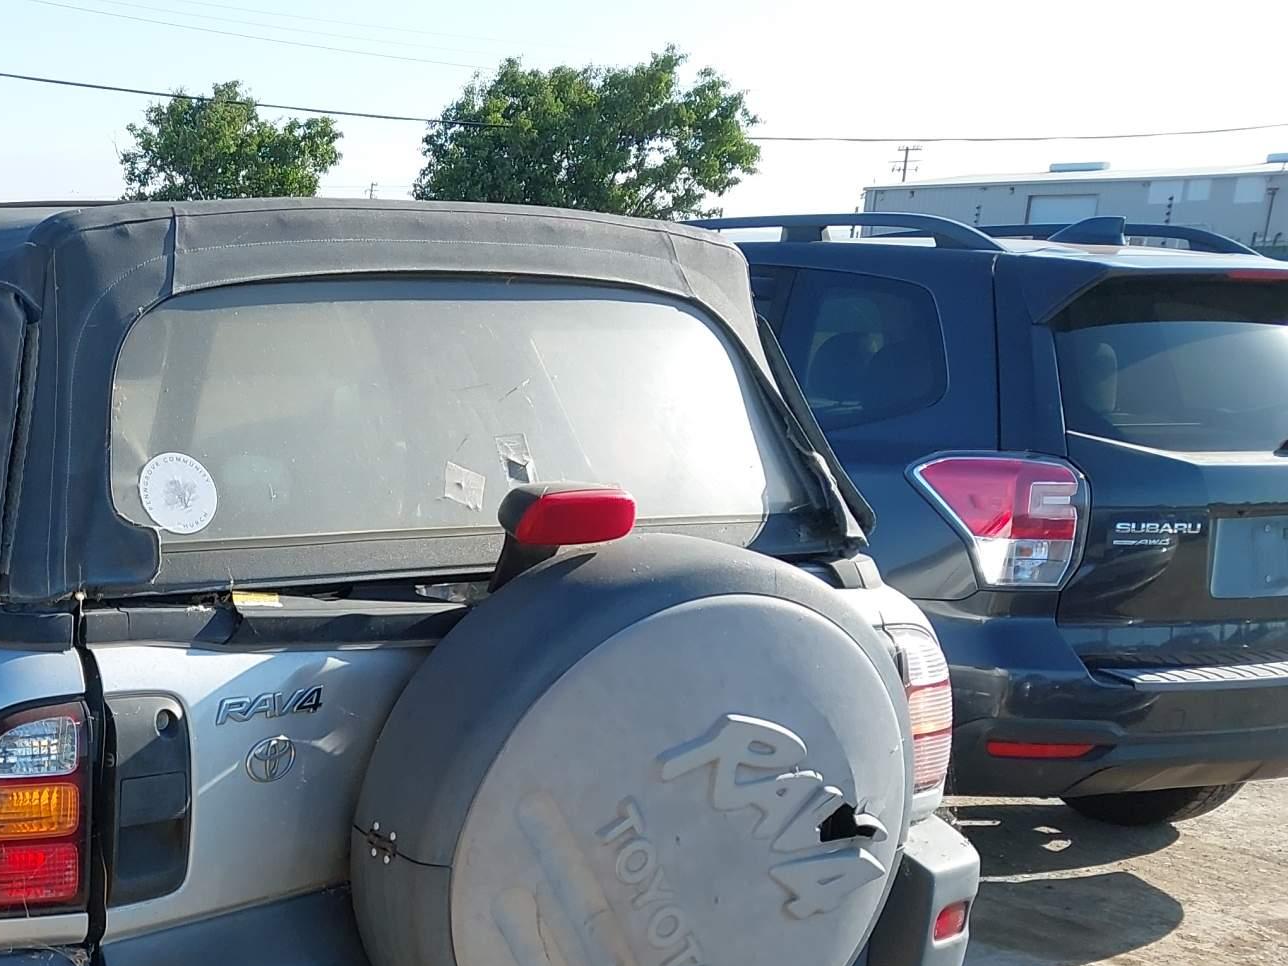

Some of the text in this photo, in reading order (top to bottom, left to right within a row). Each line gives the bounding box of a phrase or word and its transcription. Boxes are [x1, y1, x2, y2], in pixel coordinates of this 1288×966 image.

[162, 456, 210, 482] COMMUNITY
[1115, 522, 1202, 534] SUBARU
[215, 684, 324, 726] RAV4
[656, 712, 889, 921] RAV4
